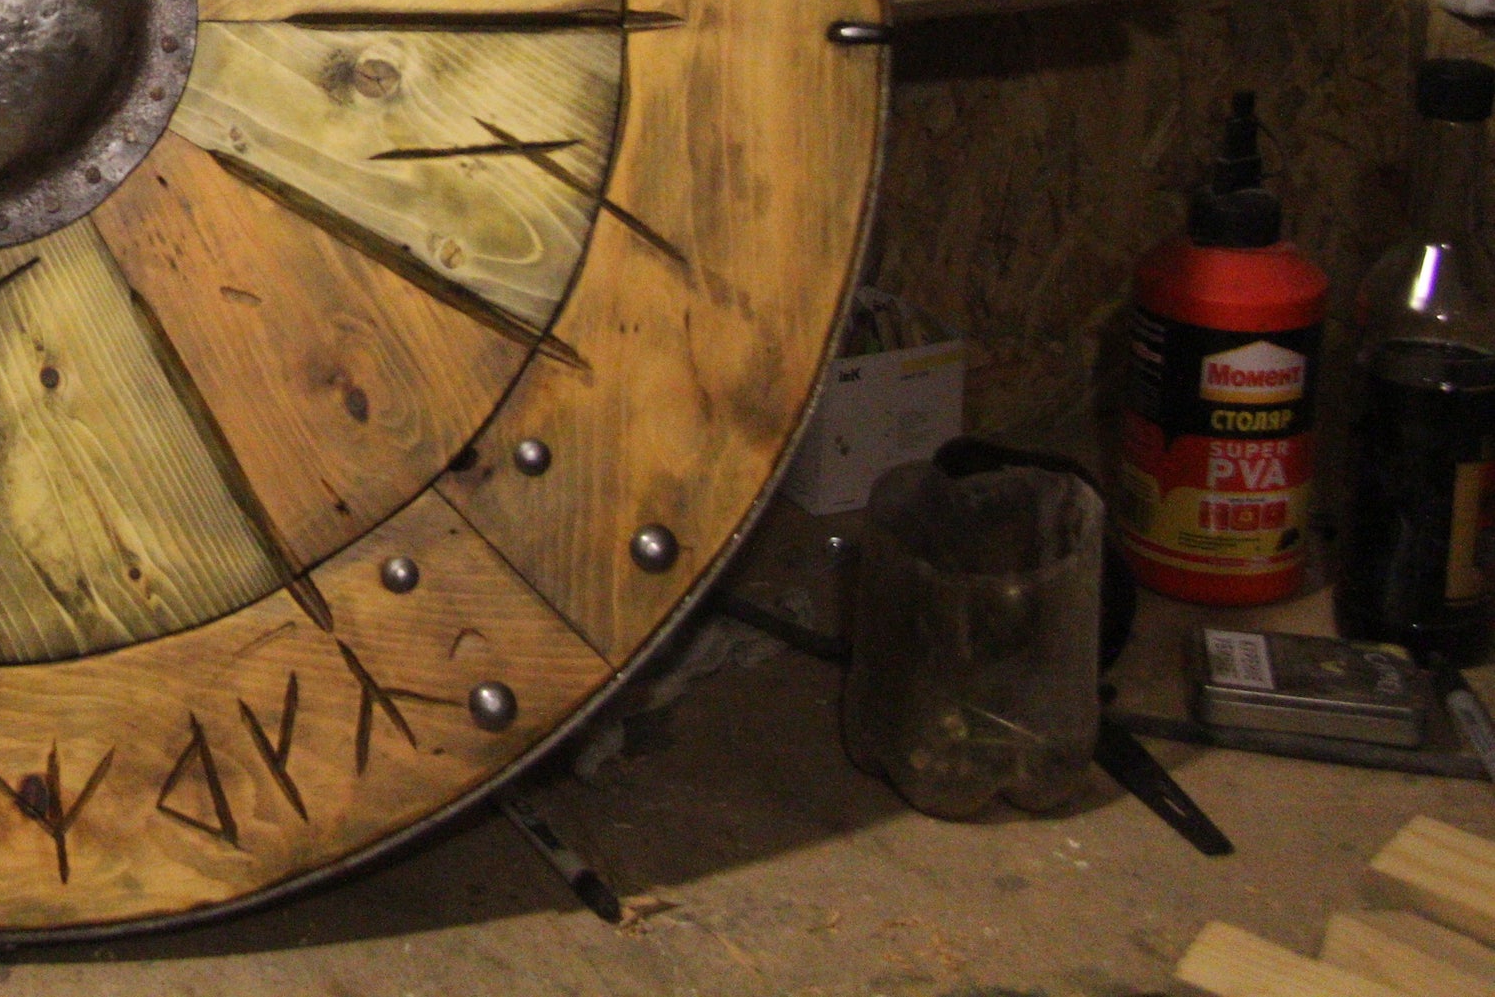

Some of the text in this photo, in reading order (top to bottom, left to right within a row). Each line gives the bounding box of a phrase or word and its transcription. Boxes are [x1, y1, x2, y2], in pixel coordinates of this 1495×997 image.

[1210, 409, 1298, 434] СТОЛЯР
[1209, 441, 1292, 460] SUPER
[1207, 459, 1289, 494] PVA
